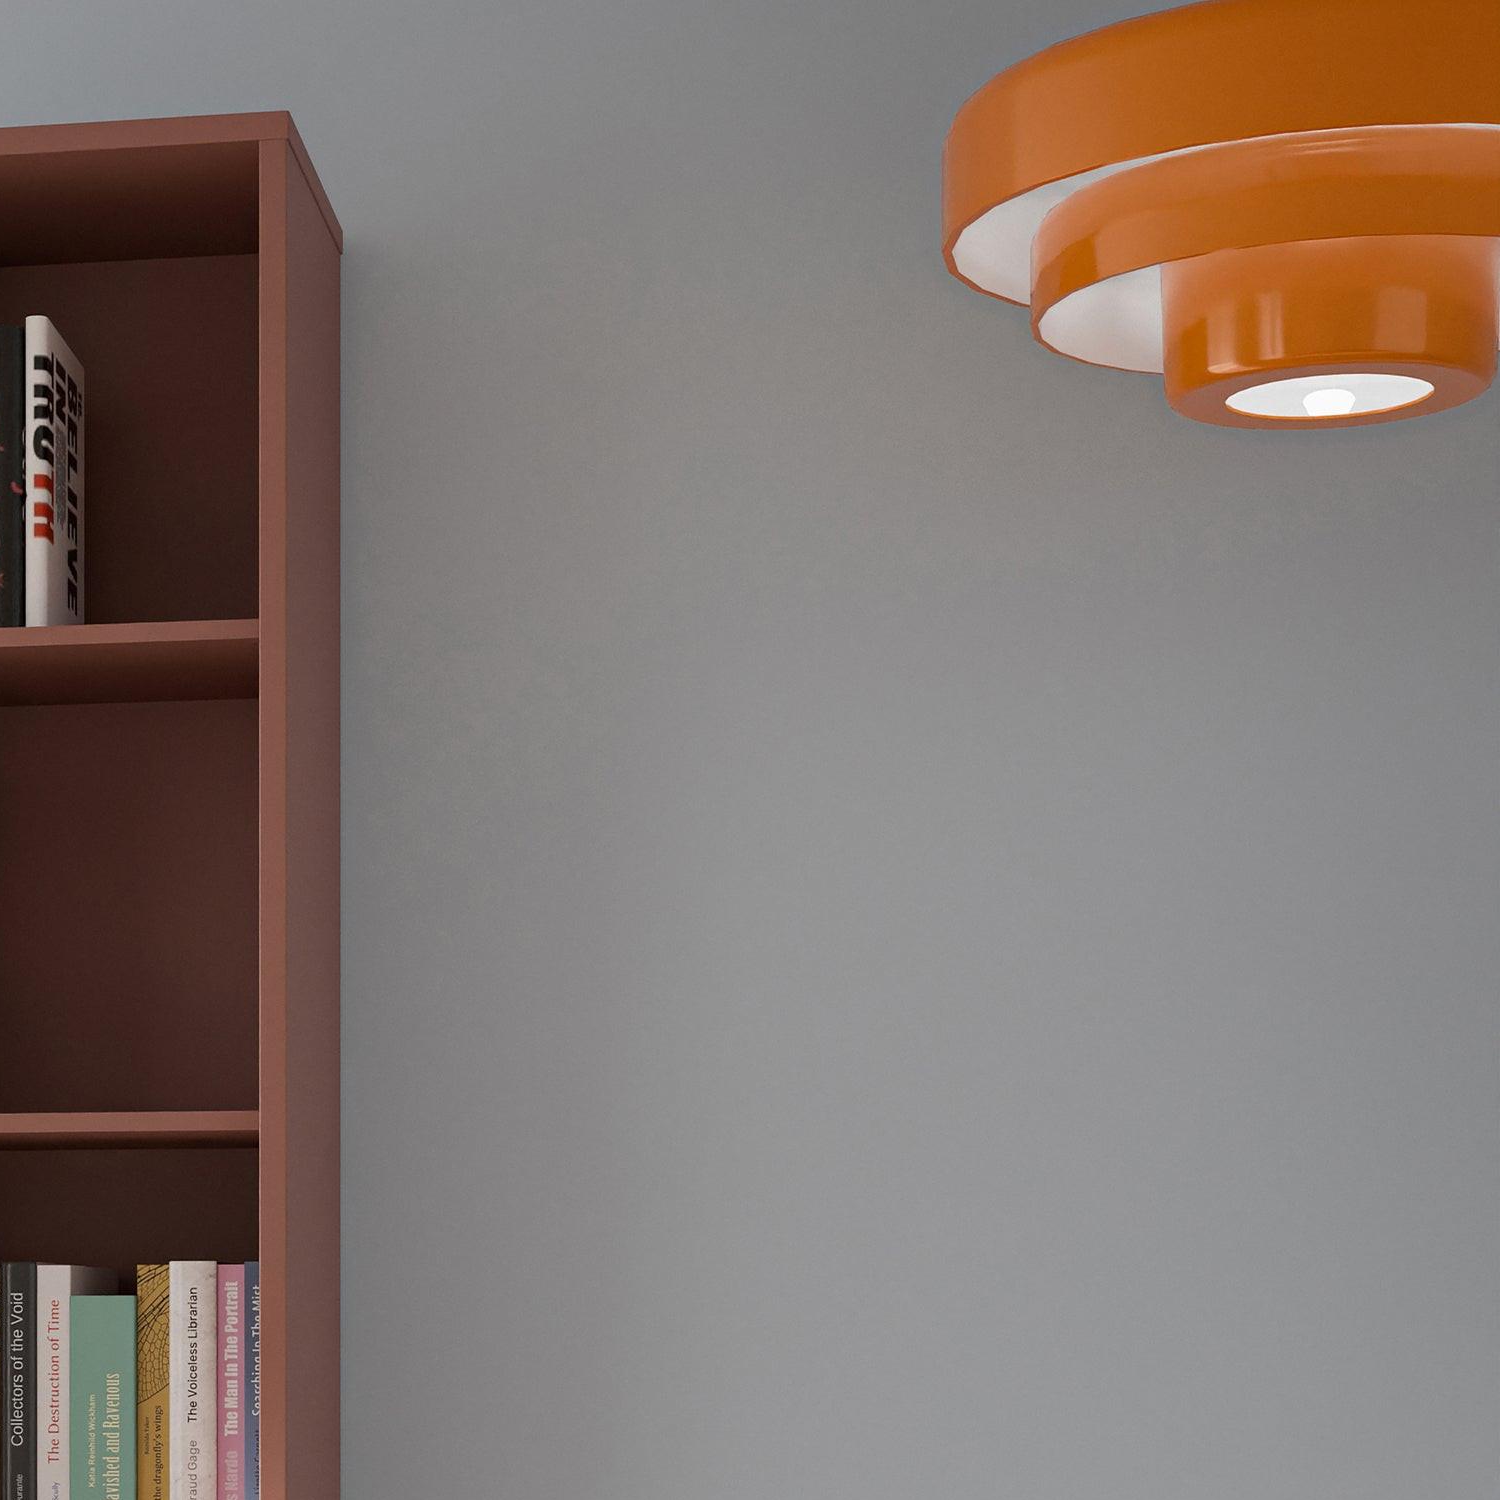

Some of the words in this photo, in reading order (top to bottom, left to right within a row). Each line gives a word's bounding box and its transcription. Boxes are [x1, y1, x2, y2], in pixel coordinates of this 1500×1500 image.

[67, 373, 77, 616] BELIEVE
[9, 1293, 24, 1324] Void
[47, 1300, 60, 1333] Time
[187, 1288, 198, 1338] Librarian
[8, 1330, 24, 1351] the
[46, 1337, 60, 1350] of
[10, 1356, 24, 1369] of
[187, 1343, 198, 1397] Voiceless
[10, 1375, 24, 1446] Collectors
[47, 1356, 60, 1433] Destruction
[102, 1374, 120, 1427] Ravenous
[187, 1401, 198, 1422] The
[47, 1439, 60, 1463] The
[102, 1433, 120, 1452] and
